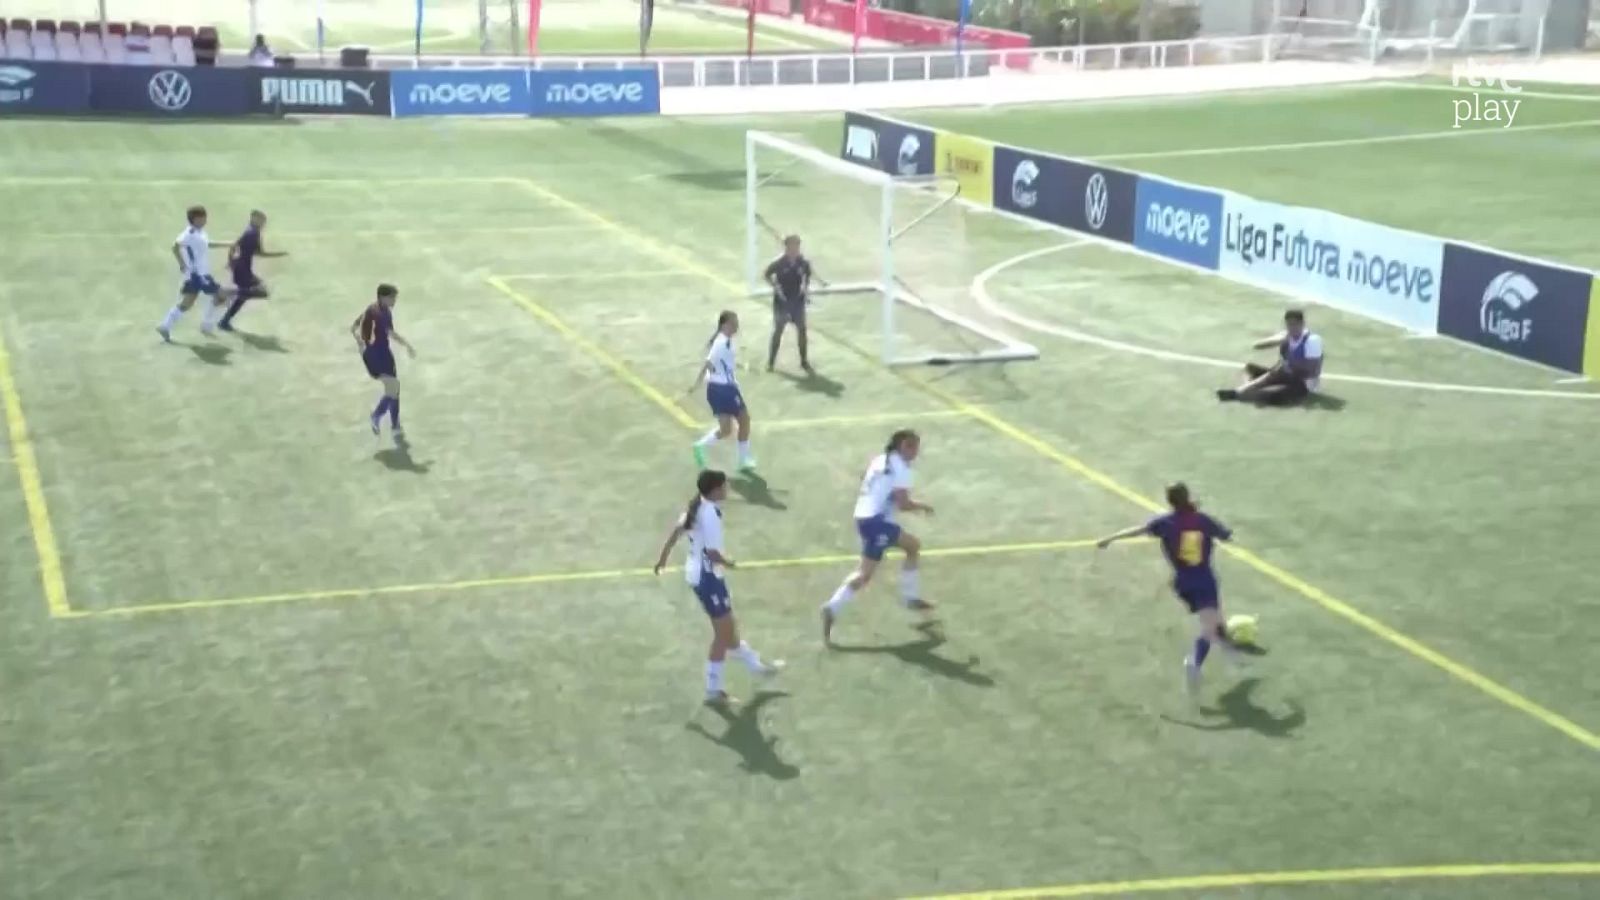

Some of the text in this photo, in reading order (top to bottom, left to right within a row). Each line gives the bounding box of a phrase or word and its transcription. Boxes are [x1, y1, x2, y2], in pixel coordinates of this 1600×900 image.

[261, 77, 344, 105] PUMA
[409, 82, 511, 104] moeve
[546, 81, 643, 103] moeve
[1146, 202, 1211, 246] moeve
[1225, 212, 1434, 303] Liga Futura moeve
[1521, 318, 1533, 342] F
